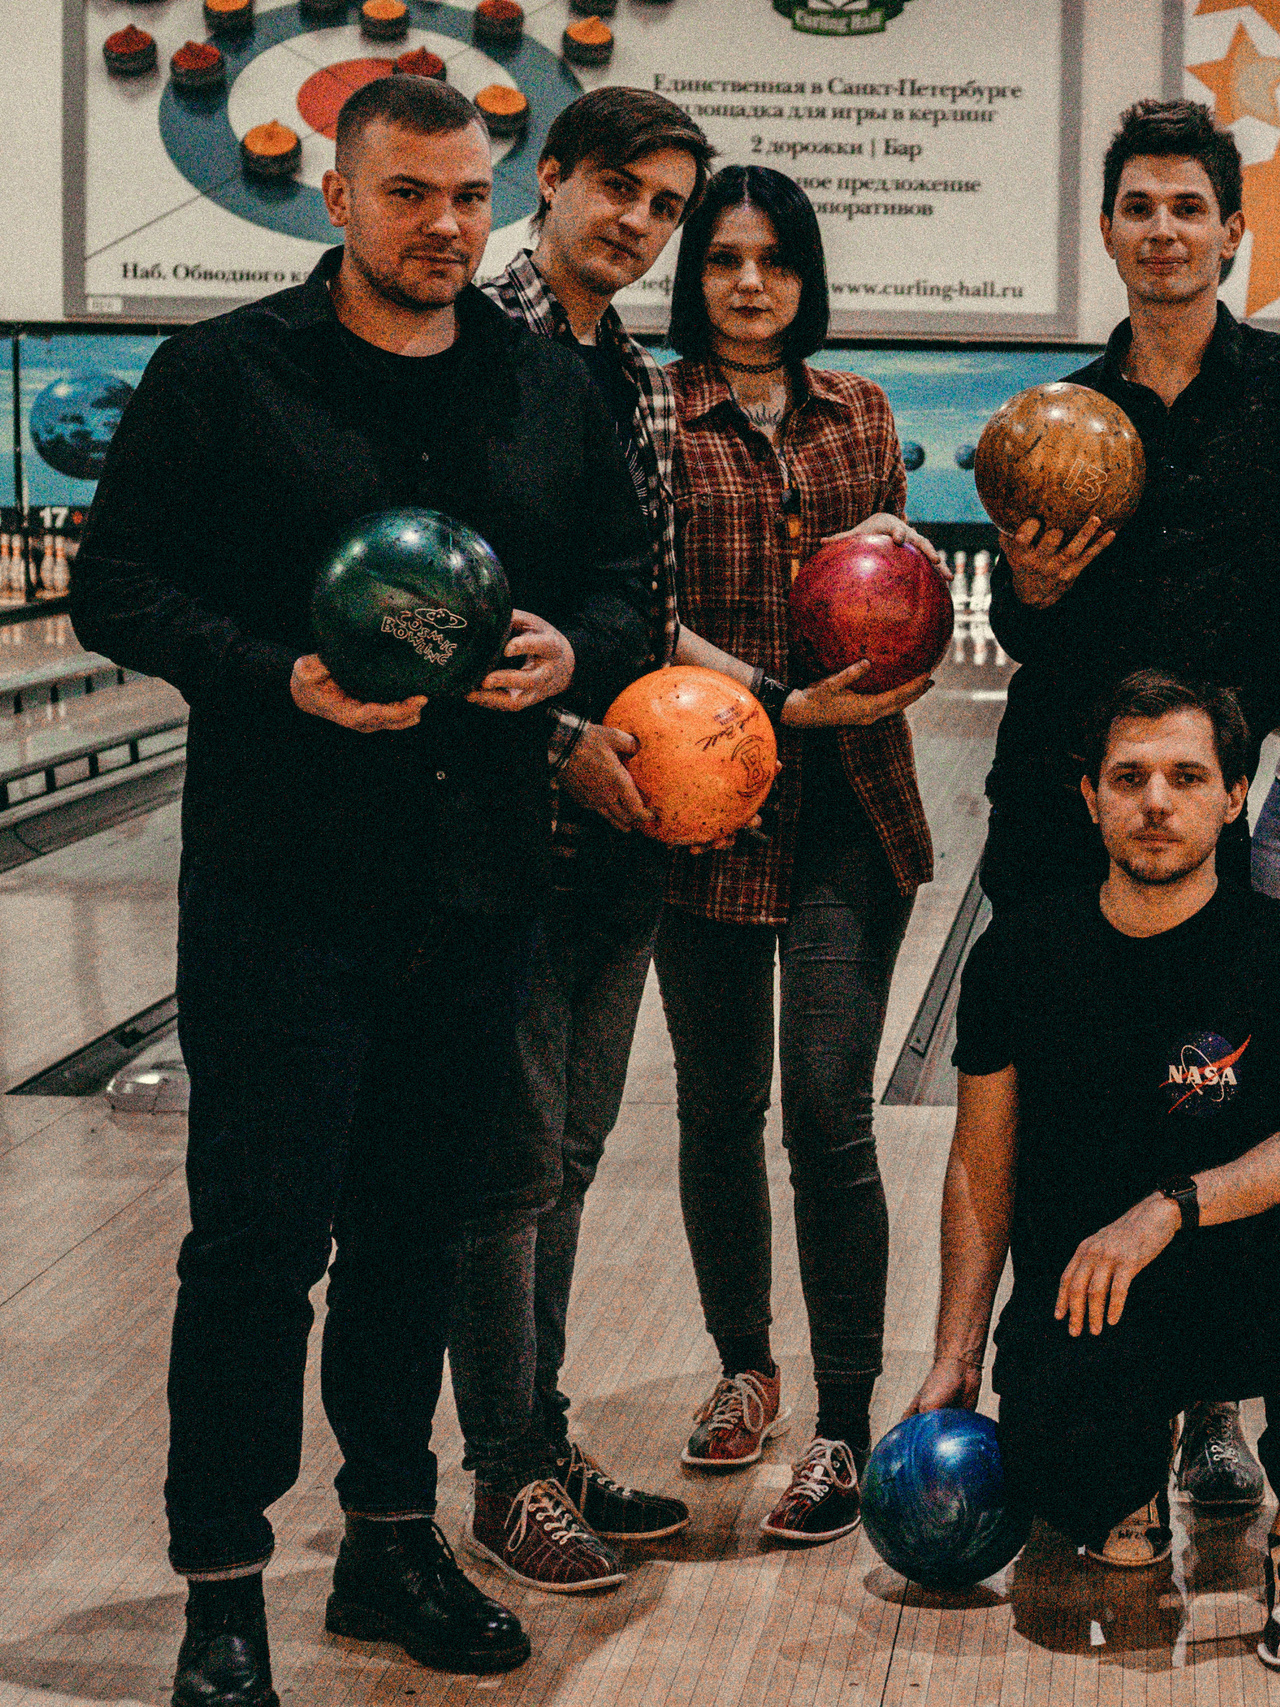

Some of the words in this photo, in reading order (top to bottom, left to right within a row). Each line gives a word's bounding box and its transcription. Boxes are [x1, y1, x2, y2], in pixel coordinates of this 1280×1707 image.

[653, 73, 805, 94] Единственная
[811, 82, 823, 94] в
[828, 77, 1022, 104] Санкт-Петербурге
[788, 106, 826, 119] для
[832, 106, 887, 126] игры
[893, 109, 904, 121] в
[909, 108, 996, 127] керлинг
[751, 135, 762, 153] 2
[766, 141, 863, 160] дорожки
[884, 138, 922, 162] Бар
[837, 177, 981, 195] предложение
[122, 262, 165, 280] Наб.
[172, 263, 284, 283] Обводного
[831, 279, 1023, 301] www.curling-hall.ru
[1063, 458, 1108, 501] 13
[40, 506, 69, 529] 17
[1168, 1065, 1237, 1085] NASA
